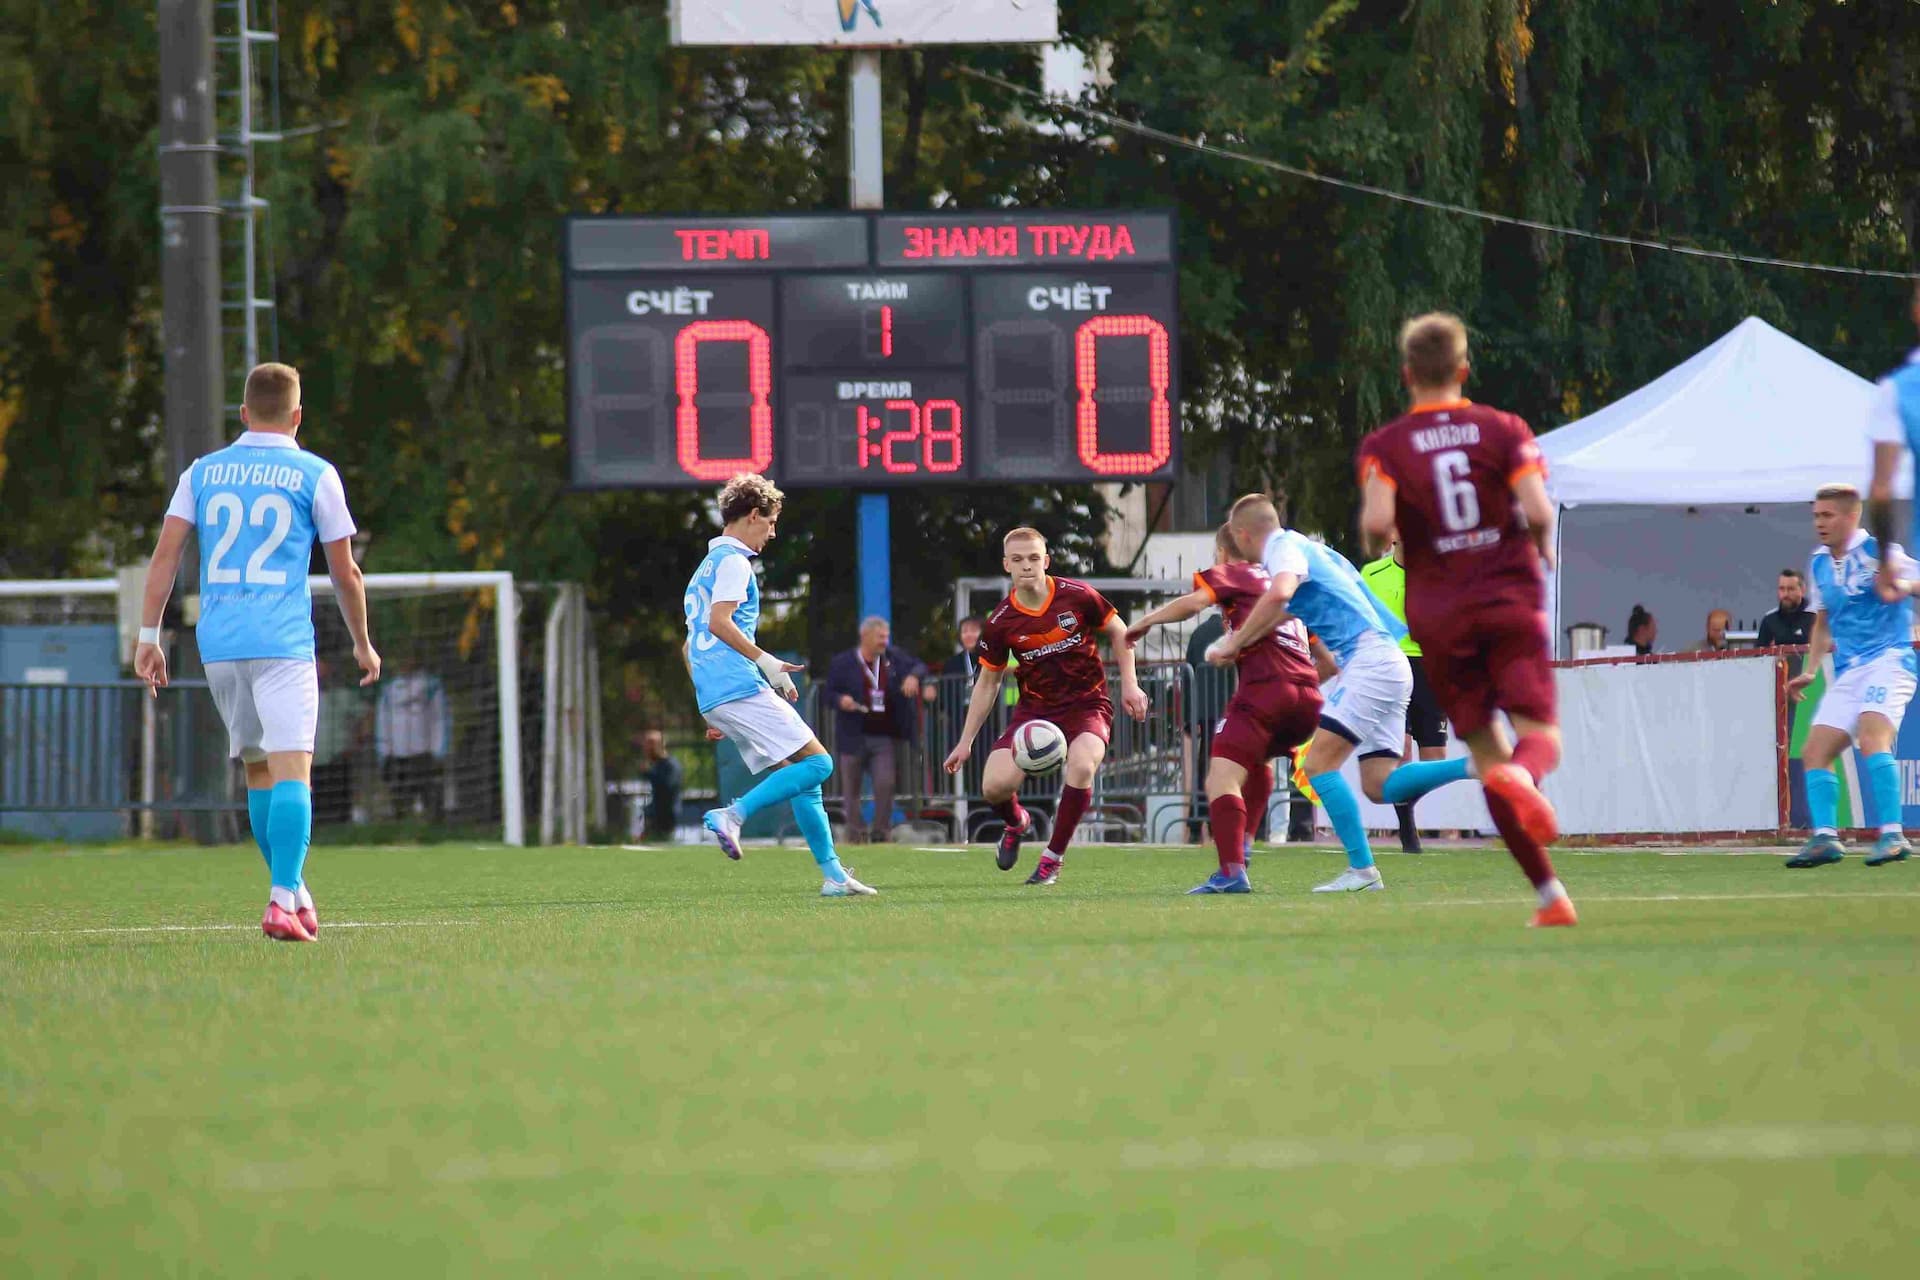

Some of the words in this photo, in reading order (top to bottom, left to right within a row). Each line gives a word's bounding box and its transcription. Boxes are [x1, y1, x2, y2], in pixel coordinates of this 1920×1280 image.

[674, 229, 769, 260] ТЕМП
[903, 226, 1018, 257] ЗНАМЯ
[1026, 224, 1135, 260] ТРУДА
[626, 287, 713, 315] СЧЁТ
[847, 279, 909, 299] ТАЙМ
[1028, 282, 1112, 310] СЧЁТ
[880, 304, 893, 358] 1
[675, 319, 773, 481] 0
[838, 382, 912, 399] ВРЕМЯ
[1075, 314, 1171, 474] 0
[856, 399, 962, 473] 1:28
[202, 462, 304, 492] ГОЛУБЦОВ
[1431, 449, 1481, 531] 6
[206, 492, 292, 585] 22
